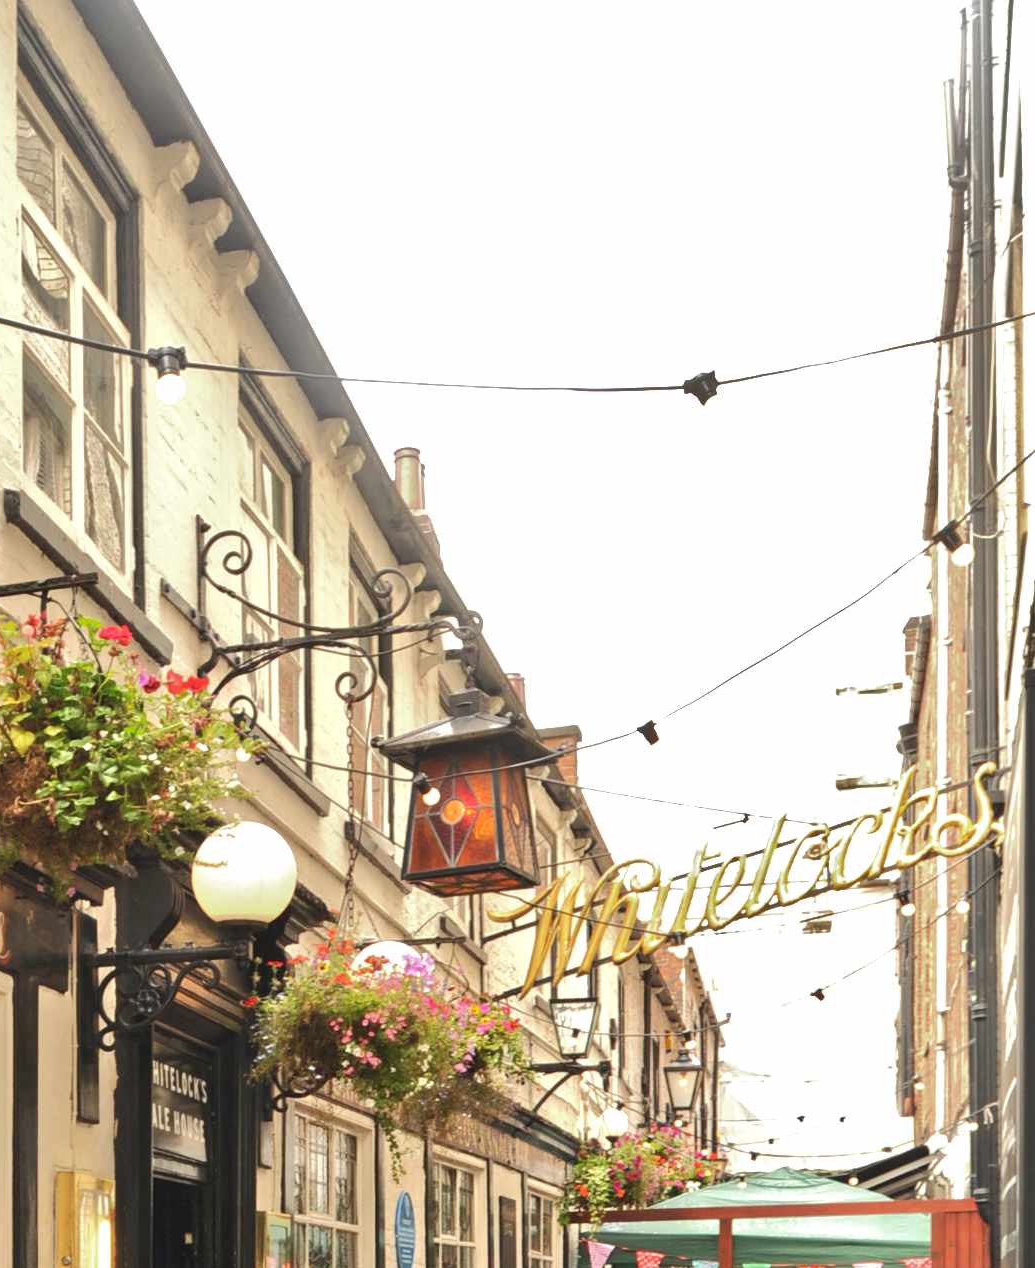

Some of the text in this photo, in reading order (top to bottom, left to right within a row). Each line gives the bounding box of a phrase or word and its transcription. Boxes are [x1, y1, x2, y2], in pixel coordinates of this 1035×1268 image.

[486, 761, 1006, 999] Whitelocks
[152, 1059, 208, 1104] HITELOCK'S
[152, 1102, 206, 1144] ALE HOUSE
